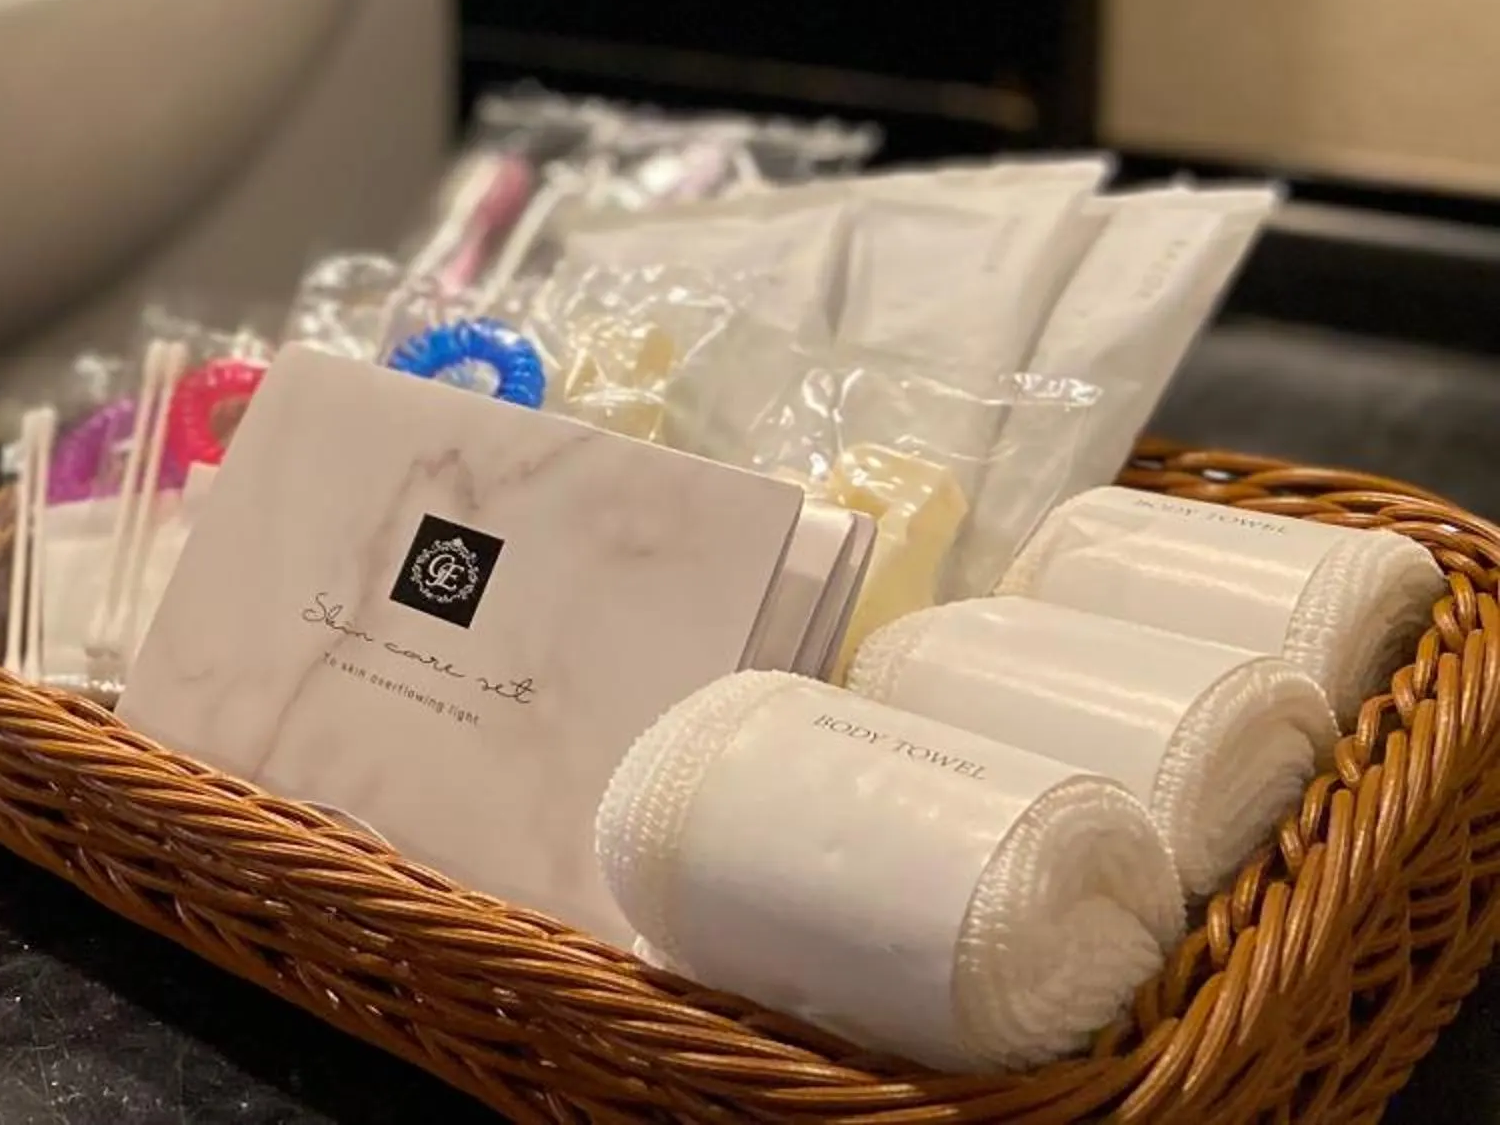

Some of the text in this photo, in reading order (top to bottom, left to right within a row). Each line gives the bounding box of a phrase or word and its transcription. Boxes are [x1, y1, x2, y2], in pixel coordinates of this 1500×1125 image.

[1205, 511, 1286, 534] TOWEL
[301, 591, 537, 705] Skin care set
[340, 661, 367, 679] skin
[368, 672, 445, 715] overflowing
[812, 713, 988, 782] BODY TOWEL
